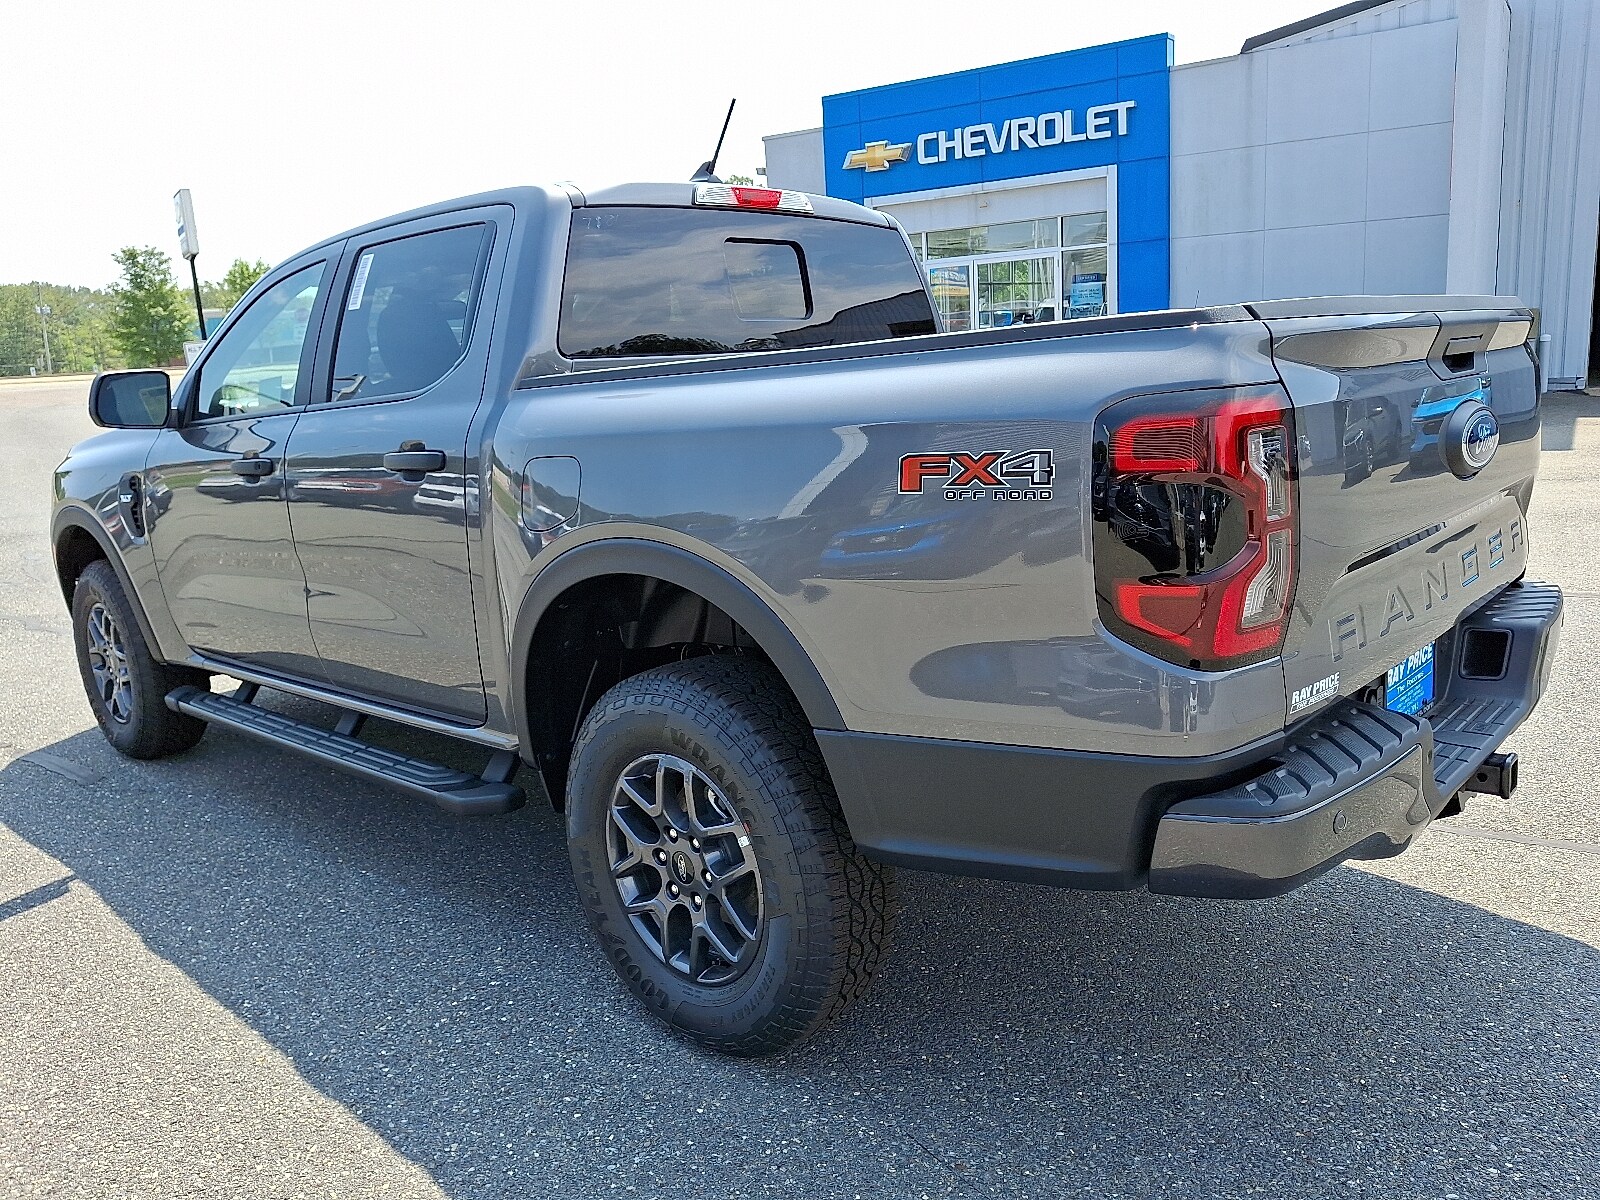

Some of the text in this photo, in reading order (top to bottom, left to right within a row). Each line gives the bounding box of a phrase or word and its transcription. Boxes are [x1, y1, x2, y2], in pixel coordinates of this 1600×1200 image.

[917, 100, 1137, 165] CHEVROLET
[898, 449, 1055, 494] FX4
[944, 489, 1053, 501] OFF ROAD
[1328, 515, 1524, 663] RANGER
[1387, 641, 1434, 688] RAY PRICE
[1292, 671, 1340, 705] RAY PRICE
